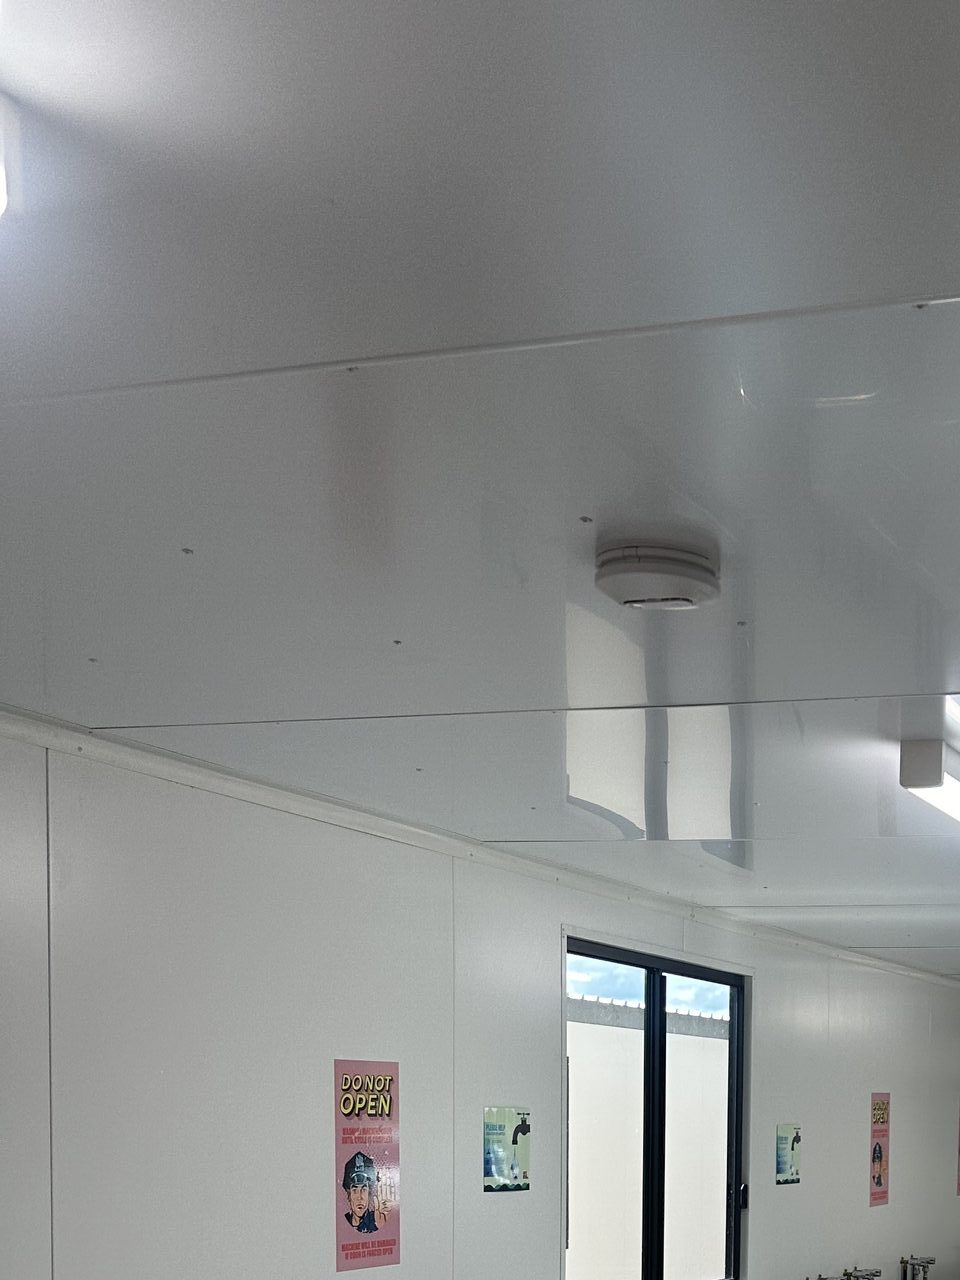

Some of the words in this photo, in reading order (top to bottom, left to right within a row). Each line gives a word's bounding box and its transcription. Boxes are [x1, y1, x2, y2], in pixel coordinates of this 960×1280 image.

[341, 1073, 363, 1092] DO
[364, 1074, 393, 1092] NOT
[340, 1092, 392, 1118] OPEN
